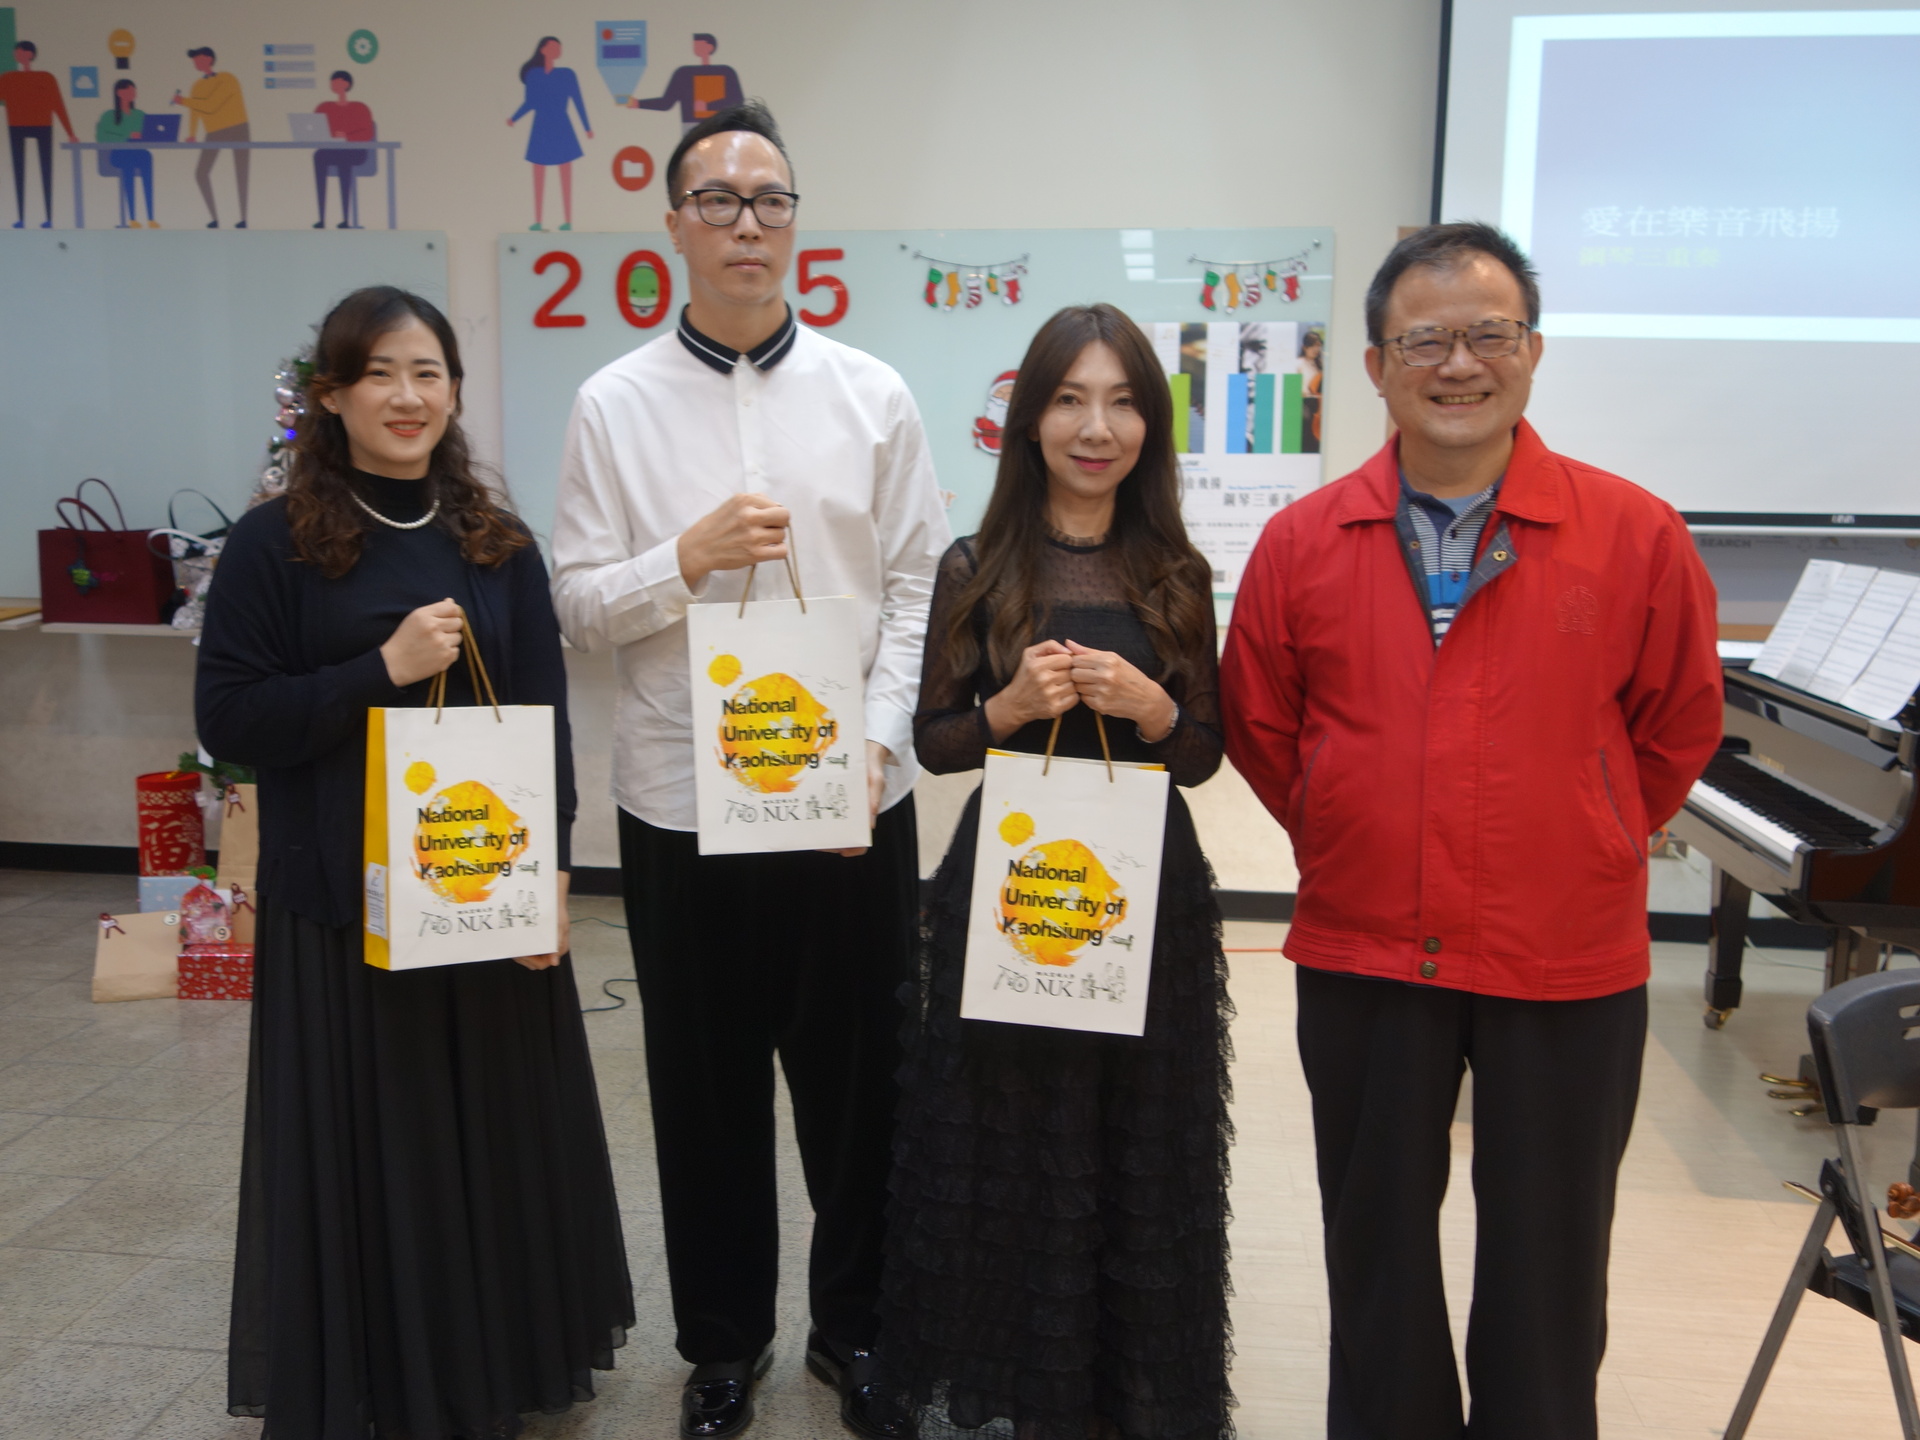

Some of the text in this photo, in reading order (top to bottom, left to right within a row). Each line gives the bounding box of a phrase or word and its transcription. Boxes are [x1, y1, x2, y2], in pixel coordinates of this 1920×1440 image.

[1581, 205, 1841, 238] 愛在樂音飛揚
[533, 249, 849, 328] 205
[722, 696, 797, 715] National
[723, 720, 836, 743] Univerity of
[725, 750, 820, 770] Kaohsiung
[417, 804, 489, 824] National
[762, 805, 801, 822] NUK
[418, 828, 527, 852] Univerity of
[420, 859, 512, 880] Kaohsiung
[1008, 859, 1088, 884] National
[1005, 887, 1125, 917] Univerity of
[457, 914, 494, 933] NUK
[1003, 916, 1103, 946] Kaohsiung
[1034, 977, 1074, 998] NUK
